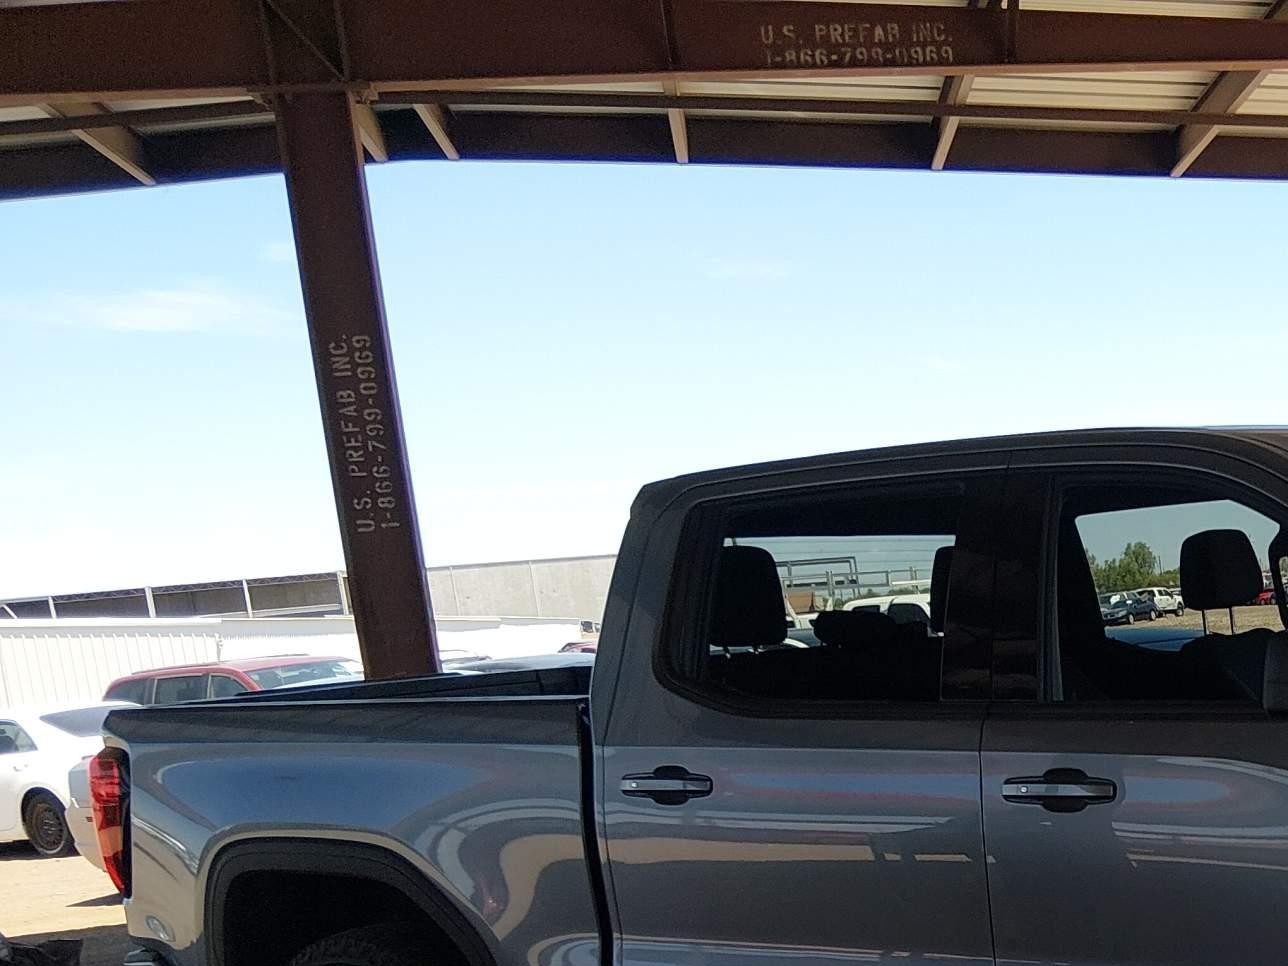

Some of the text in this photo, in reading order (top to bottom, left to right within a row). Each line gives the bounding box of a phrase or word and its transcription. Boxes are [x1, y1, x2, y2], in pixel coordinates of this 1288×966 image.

[760, 24, 803, 44] U.S.
[912, 22, 953, 42] INC.
[328, 334, 376, 533] U.S. PREFAB INC.
[352, 335, 400, 529] 1-866-799-0969
